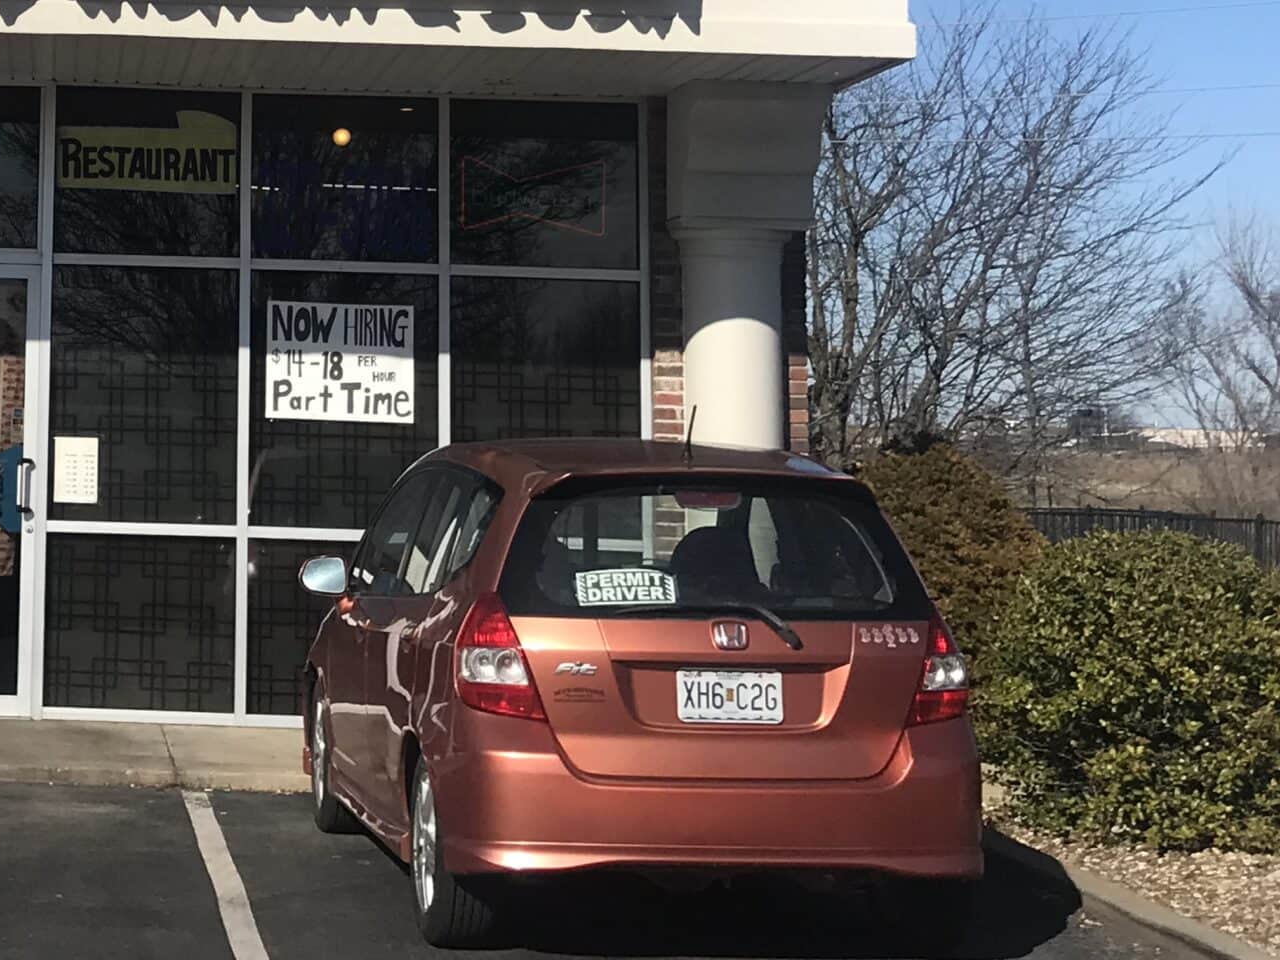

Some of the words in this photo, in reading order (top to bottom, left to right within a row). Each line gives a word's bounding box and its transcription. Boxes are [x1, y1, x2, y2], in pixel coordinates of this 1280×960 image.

[62, 139, 236, 184] RESTAURANT
[271, 304, 338, 344] NOW
[343, 307, 410, 348] HIRING
[357, 355, 378, 368] PER
[372, 371, 397, 383] HOUR
[272, 379, 333, 413] Part
[339, 382, 412, 418] Time
[585, 572, 663, 588] PERMIT
[586, 586, 665, 602] DRIVER
[683, 681, 725, 710] XH6
[736, 683, 778, 712] C2G
